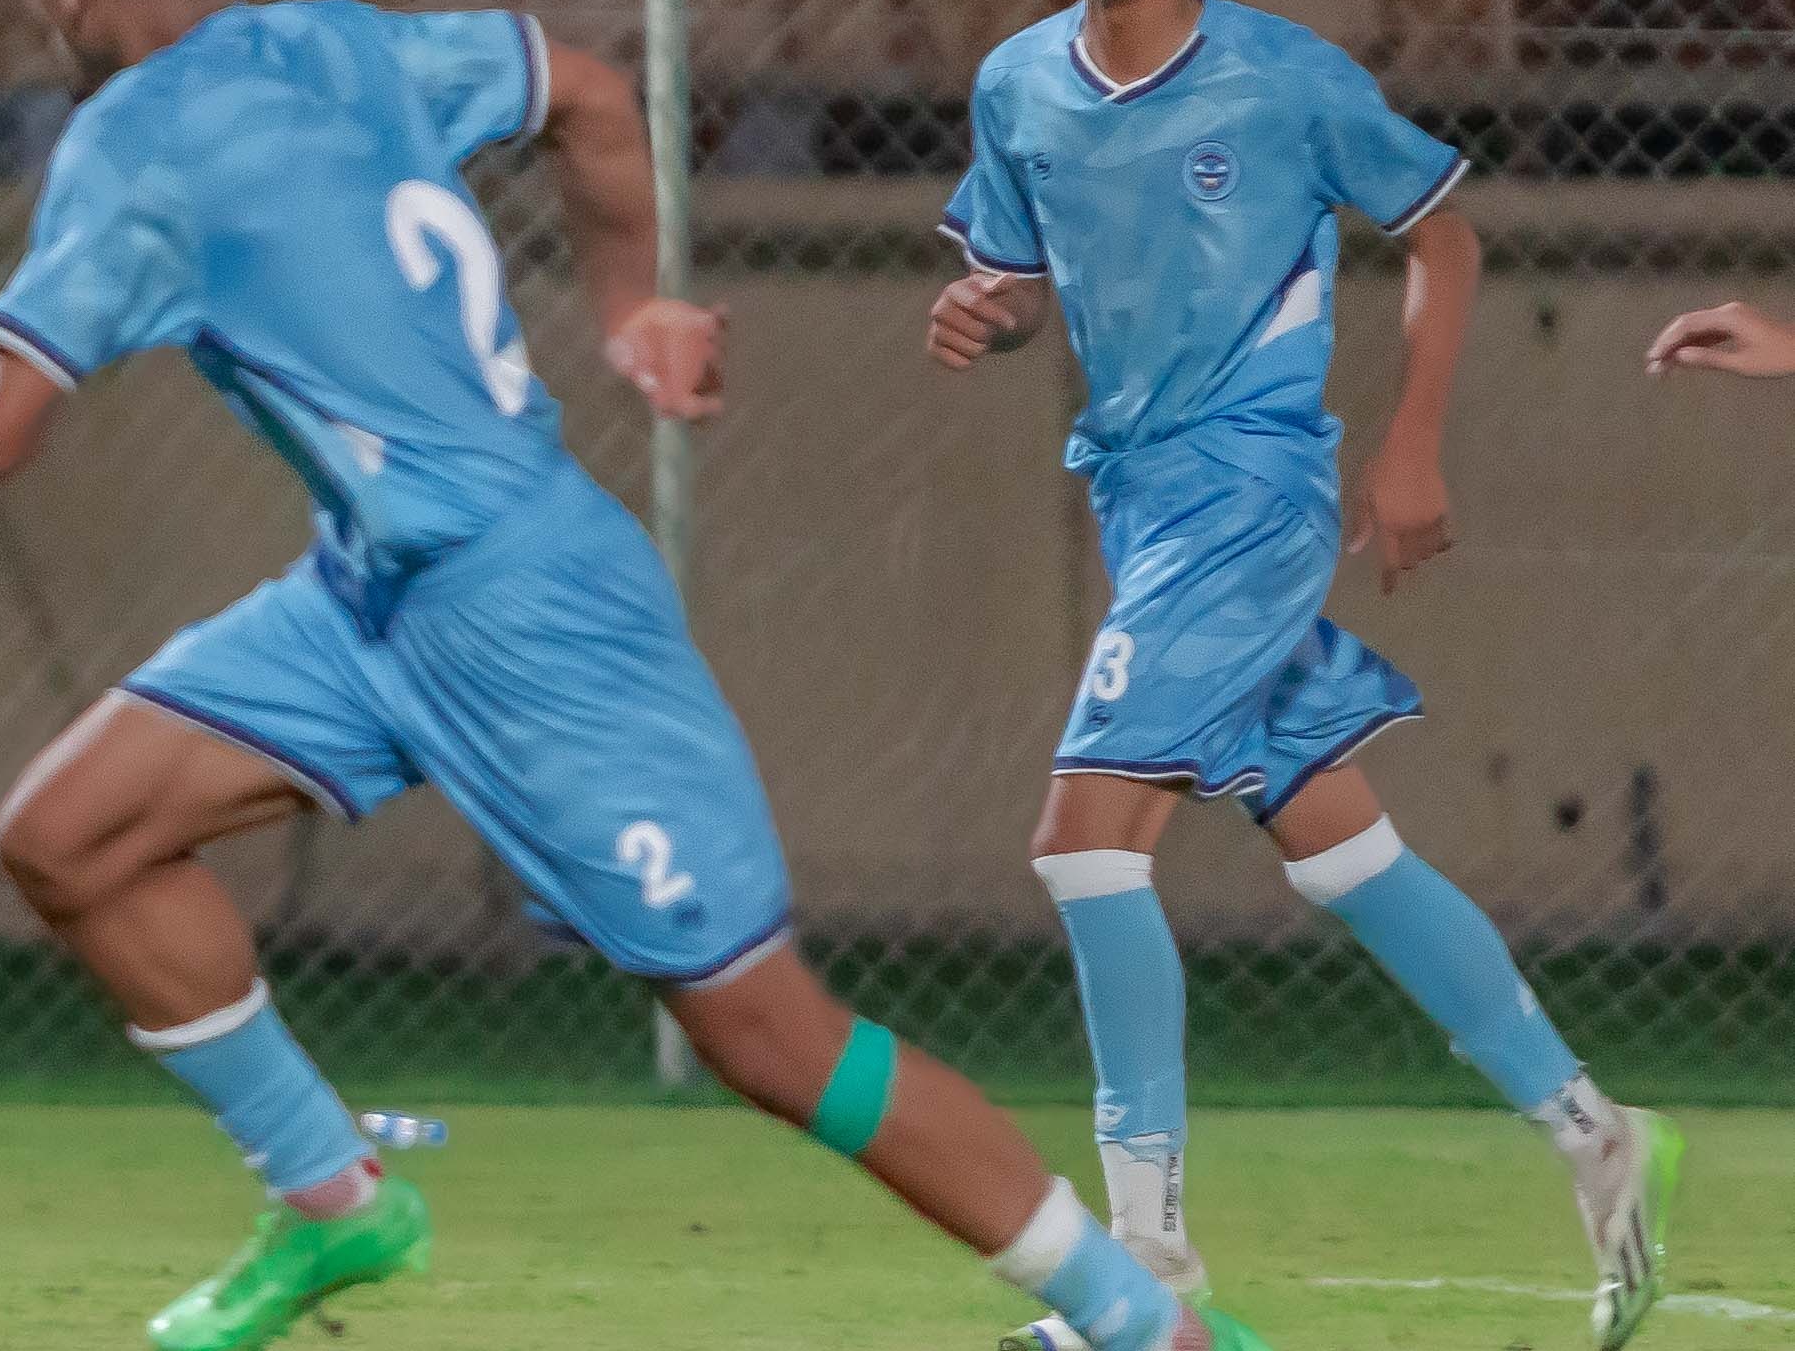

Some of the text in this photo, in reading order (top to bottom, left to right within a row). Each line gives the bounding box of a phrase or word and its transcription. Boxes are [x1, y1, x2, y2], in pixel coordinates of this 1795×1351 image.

[385, 179, 529, 416] 2
[1092, 631, 1136, 701] 3
[615, 819, 695, 909] 2
